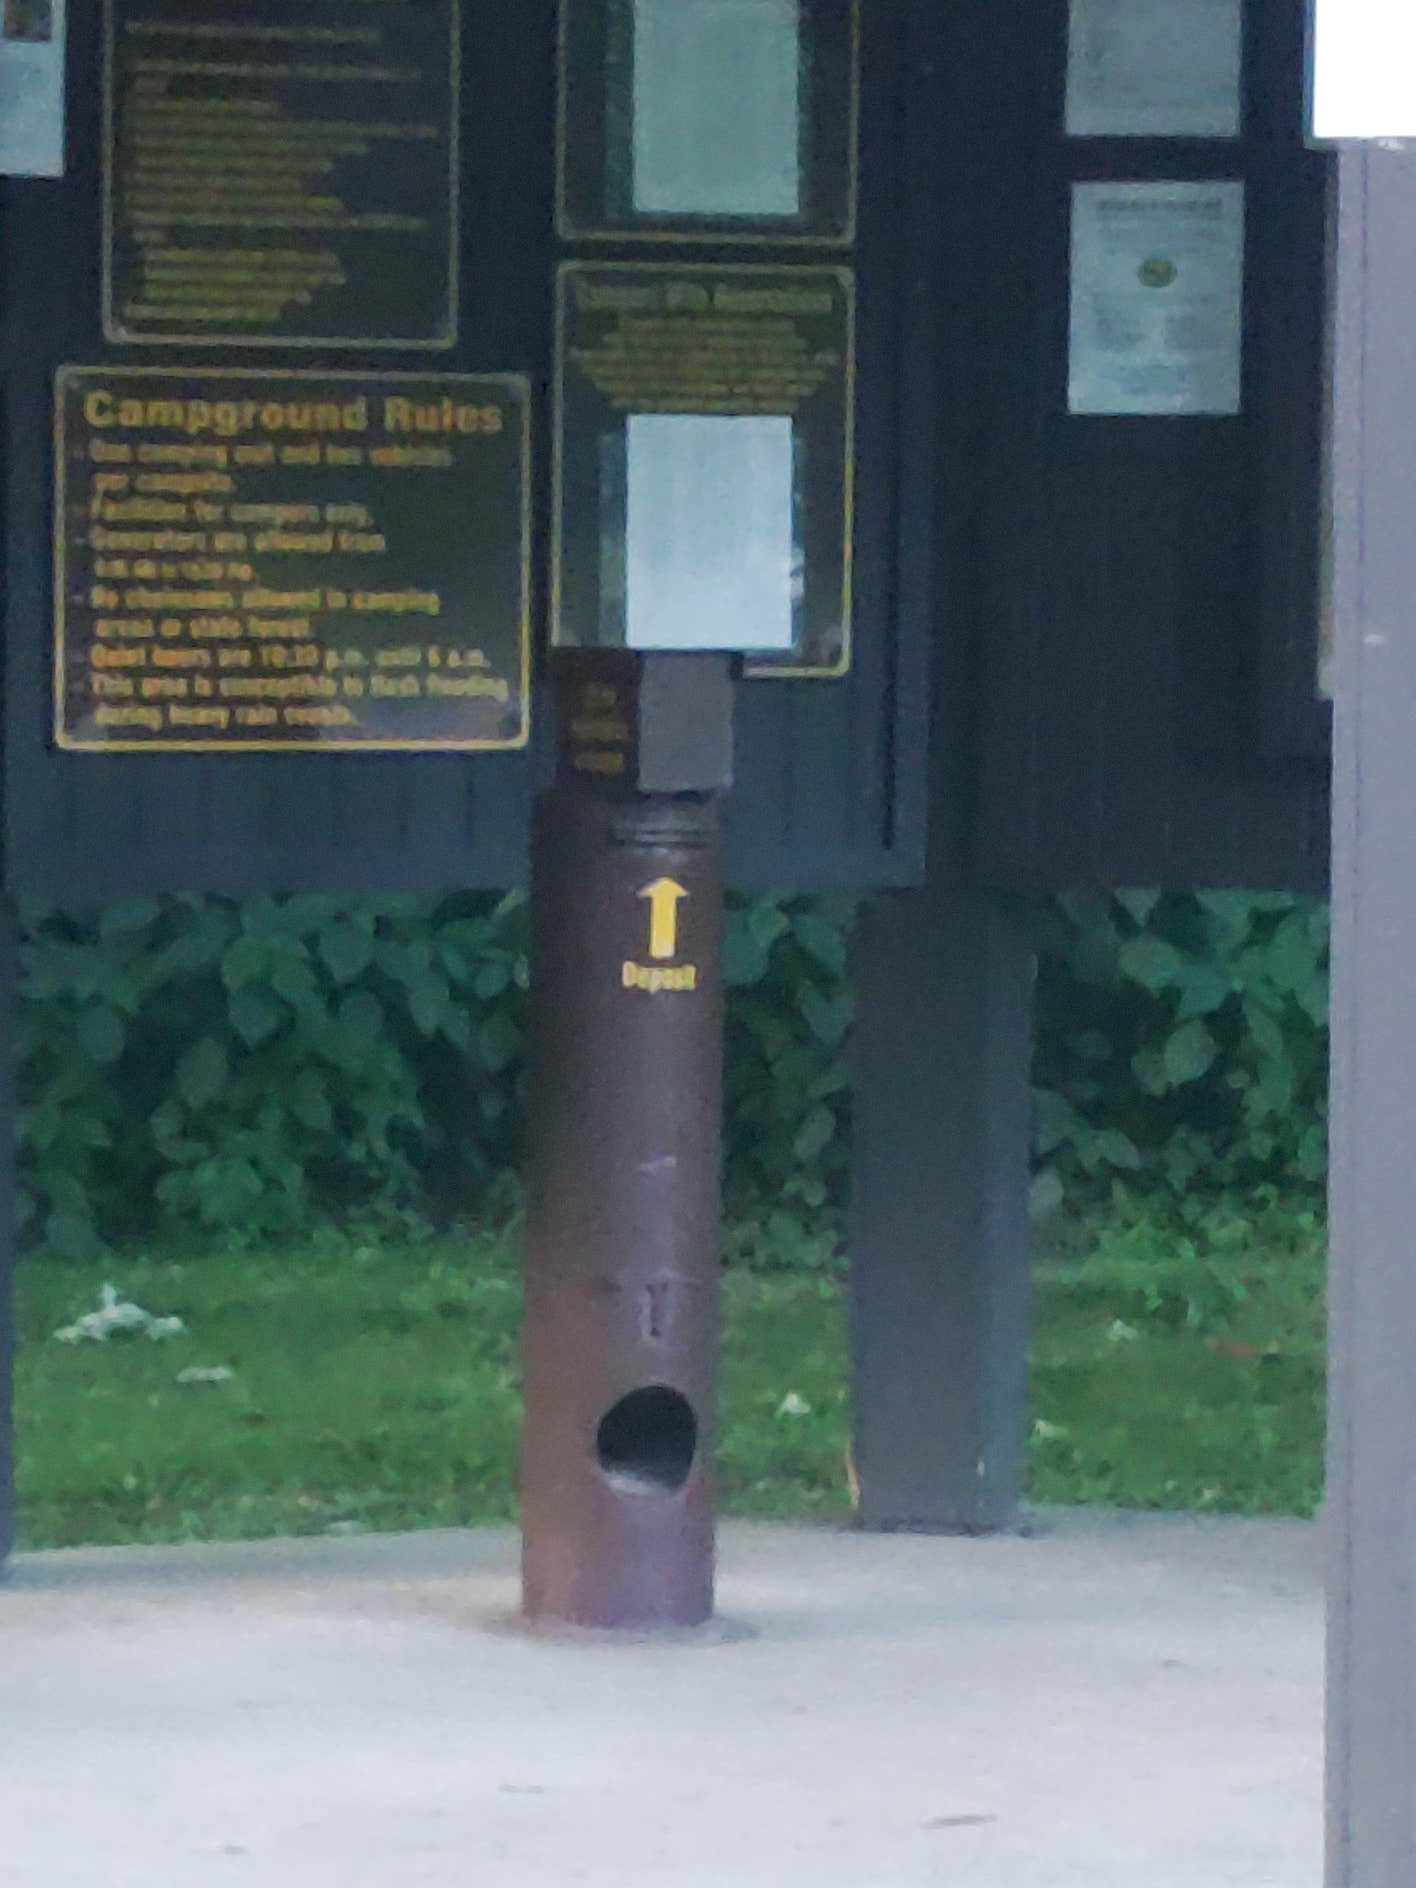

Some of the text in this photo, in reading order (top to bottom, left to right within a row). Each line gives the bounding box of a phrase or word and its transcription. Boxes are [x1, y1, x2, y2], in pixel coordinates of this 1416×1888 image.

[84, 390, 502, 436] Campground Rules
[353, 590, 440, 615] camping
[90, 643, 146, 668] Quiet
[92, 671, 133, 696] This
[140, 675, 188, 696] area
[195, 674, 213, 696] is
[343, 674, 363, 697] to
[96, 706, 162, 731] during
[169, 705, 229, 730] heavy
[235, 706, 278, 727] rain
